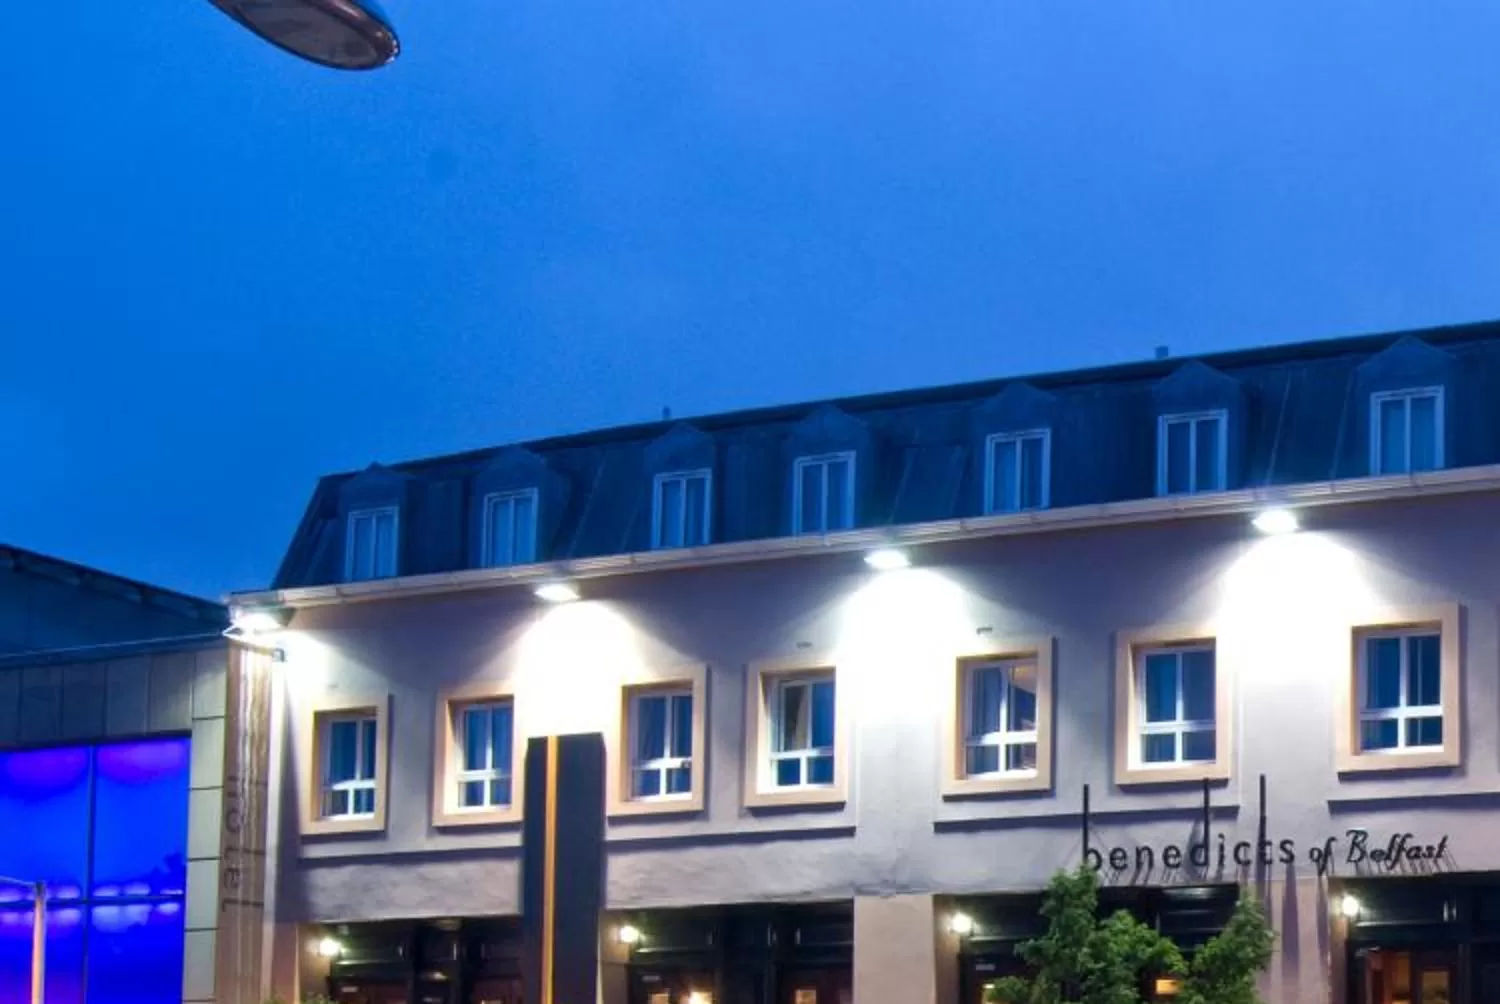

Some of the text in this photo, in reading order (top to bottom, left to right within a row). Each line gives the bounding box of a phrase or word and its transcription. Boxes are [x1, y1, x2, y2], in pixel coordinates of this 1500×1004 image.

[1083, 774, 1449, 875] benedicts of Belfast
